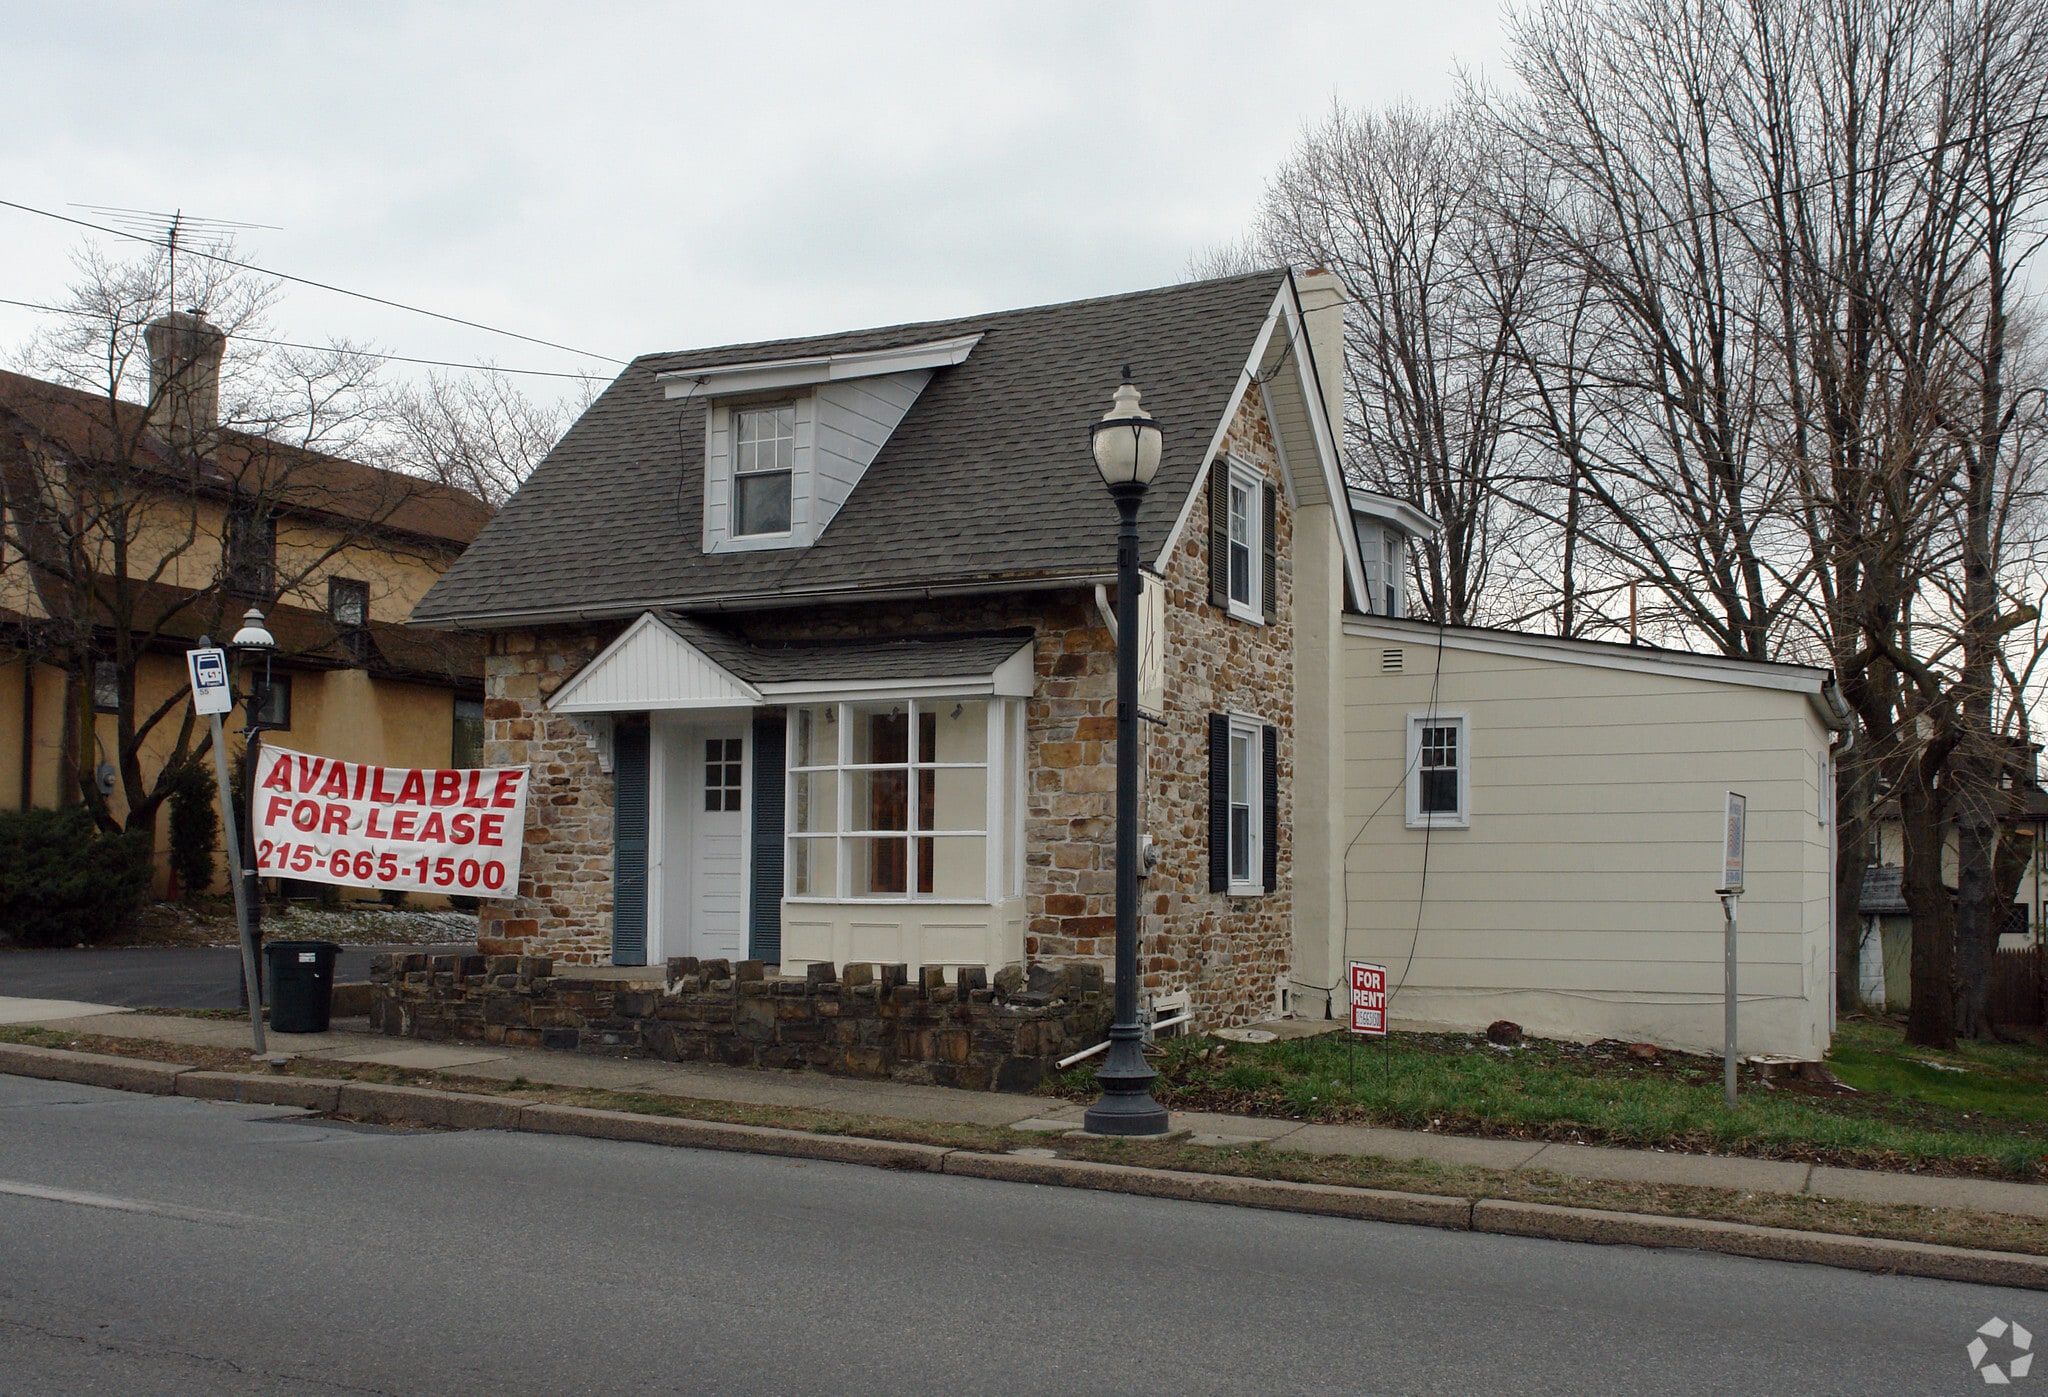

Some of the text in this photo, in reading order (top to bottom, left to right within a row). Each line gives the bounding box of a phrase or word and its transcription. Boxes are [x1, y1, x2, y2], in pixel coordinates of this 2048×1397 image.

[262, 754, 523, 809] AVAILABLE
[265, 795, 505, 847] FOR LEASE
[257, 839, 506, 890] 215-665-1500
[1353, 989, 1384, 1008] RENT
[1357, 971, 1380, 989] FOR
